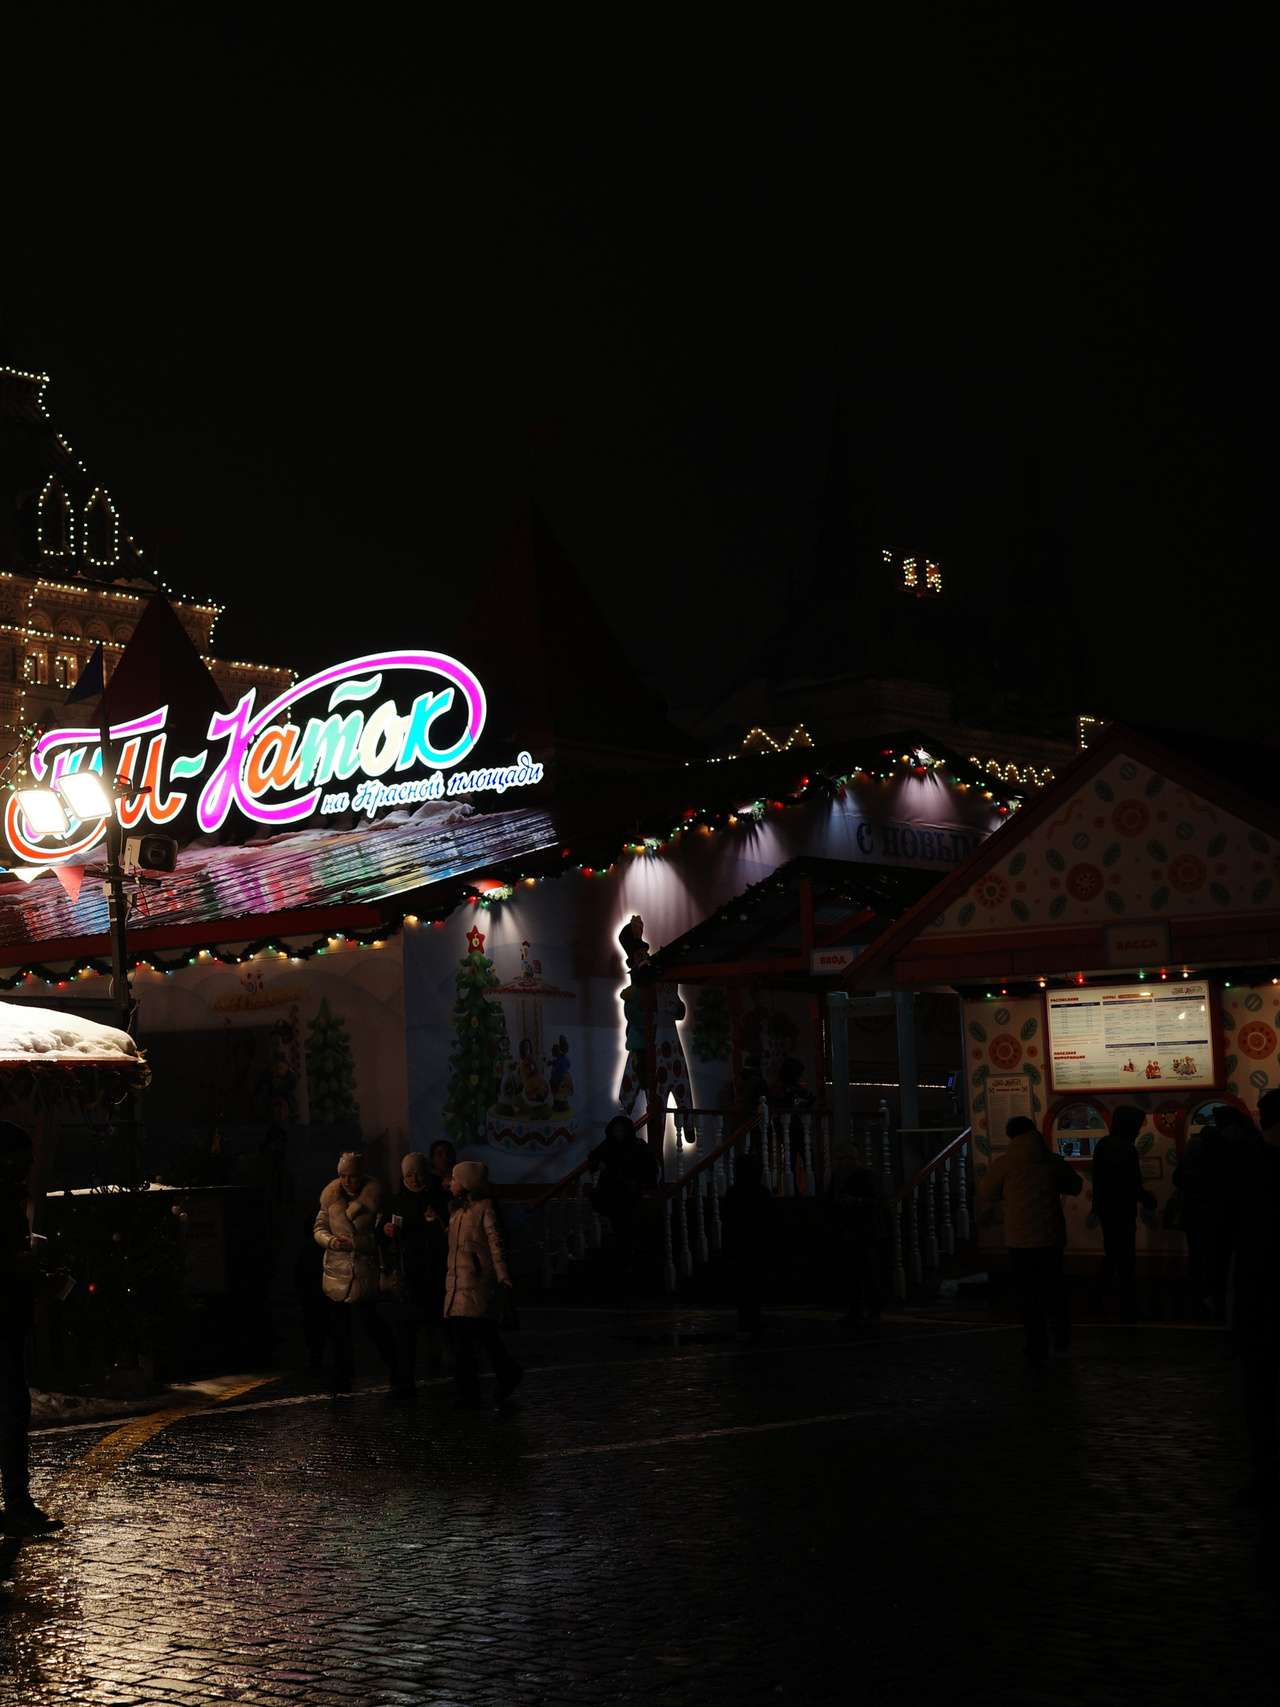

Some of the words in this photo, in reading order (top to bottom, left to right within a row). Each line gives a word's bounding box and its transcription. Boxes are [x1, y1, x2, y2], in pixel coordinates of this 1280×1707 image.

[320, 792, 347, 816] на
[351, 771, 445, 818] Красной
[448, 750, 545, 800] площади
[856, 823, 873, 854] С
[1116, 939, 1158, 952] КАССА
[820, 955, 846, 965] ВХОД
